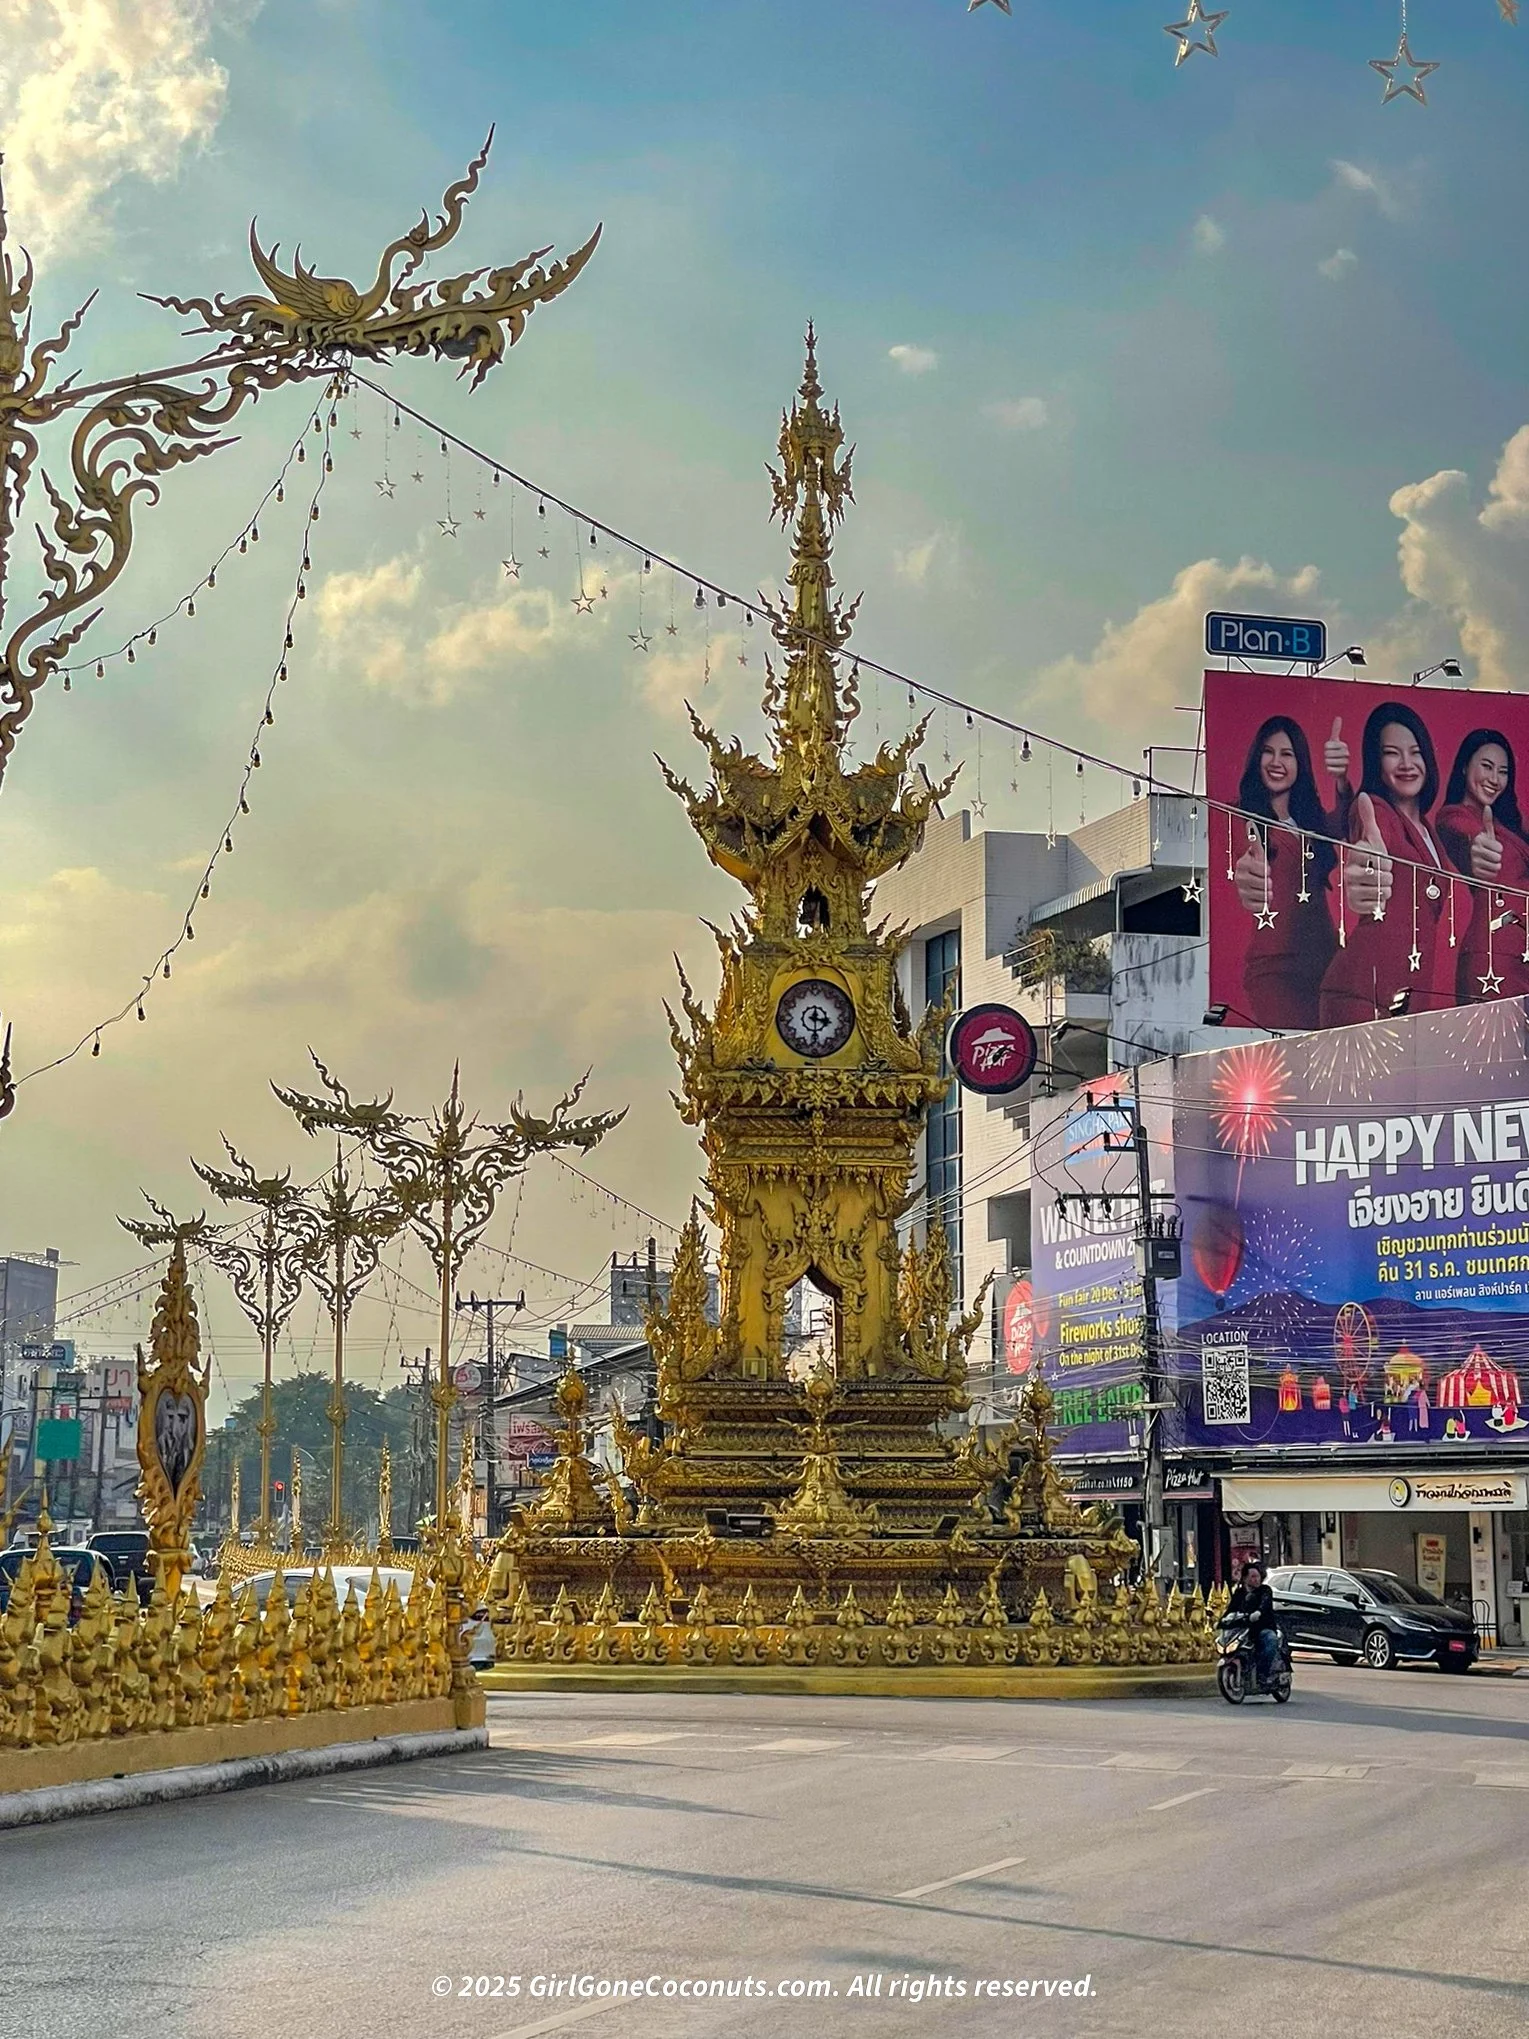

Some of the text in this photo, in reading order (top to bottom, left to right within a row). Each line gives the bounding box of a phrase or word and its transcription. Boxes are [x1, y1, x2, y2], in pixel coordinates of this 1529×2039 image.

[1296, 1114, 1444, 1185] HAPPY
[1040, 1178, 1166, 1245] WINTER FET
[1348, 1185, 1464, 1229] เจียงฮาย
[1055, 1252, 1064, 1270] &
[1064, 1238, 1126, 1267] COUNTDOWN
[1378, 1261, 1399, 1282] คืน
[1404, 1260, 1422, 1280] 31
[1429, 1260, 1461, 1279] ธ.ค.
[1059, 1292, 1074, 1308] Fun
[1075, 1288, 1090, 1306] fair
[1102, 1286, 1118, 1302] Dec
[1415, 1288, 1433, 1301] ลาน
[1060, 1316, 1113, 1344] Fireworks
[1201, 1330, 1249, 1345] LOCATION
[1059, 1352, 1070, 1368] On
[1070, 1350, 1083, 1365] the
[1083, 1346, 1103, 1366] night
[1104, 1344, 1113, 1361] of
[1053, 1388, 1093, 1426] FREE
[1165, 1468, 1187, 1489] Pizza
[1187, 1468, 1205, 1486] Hut
